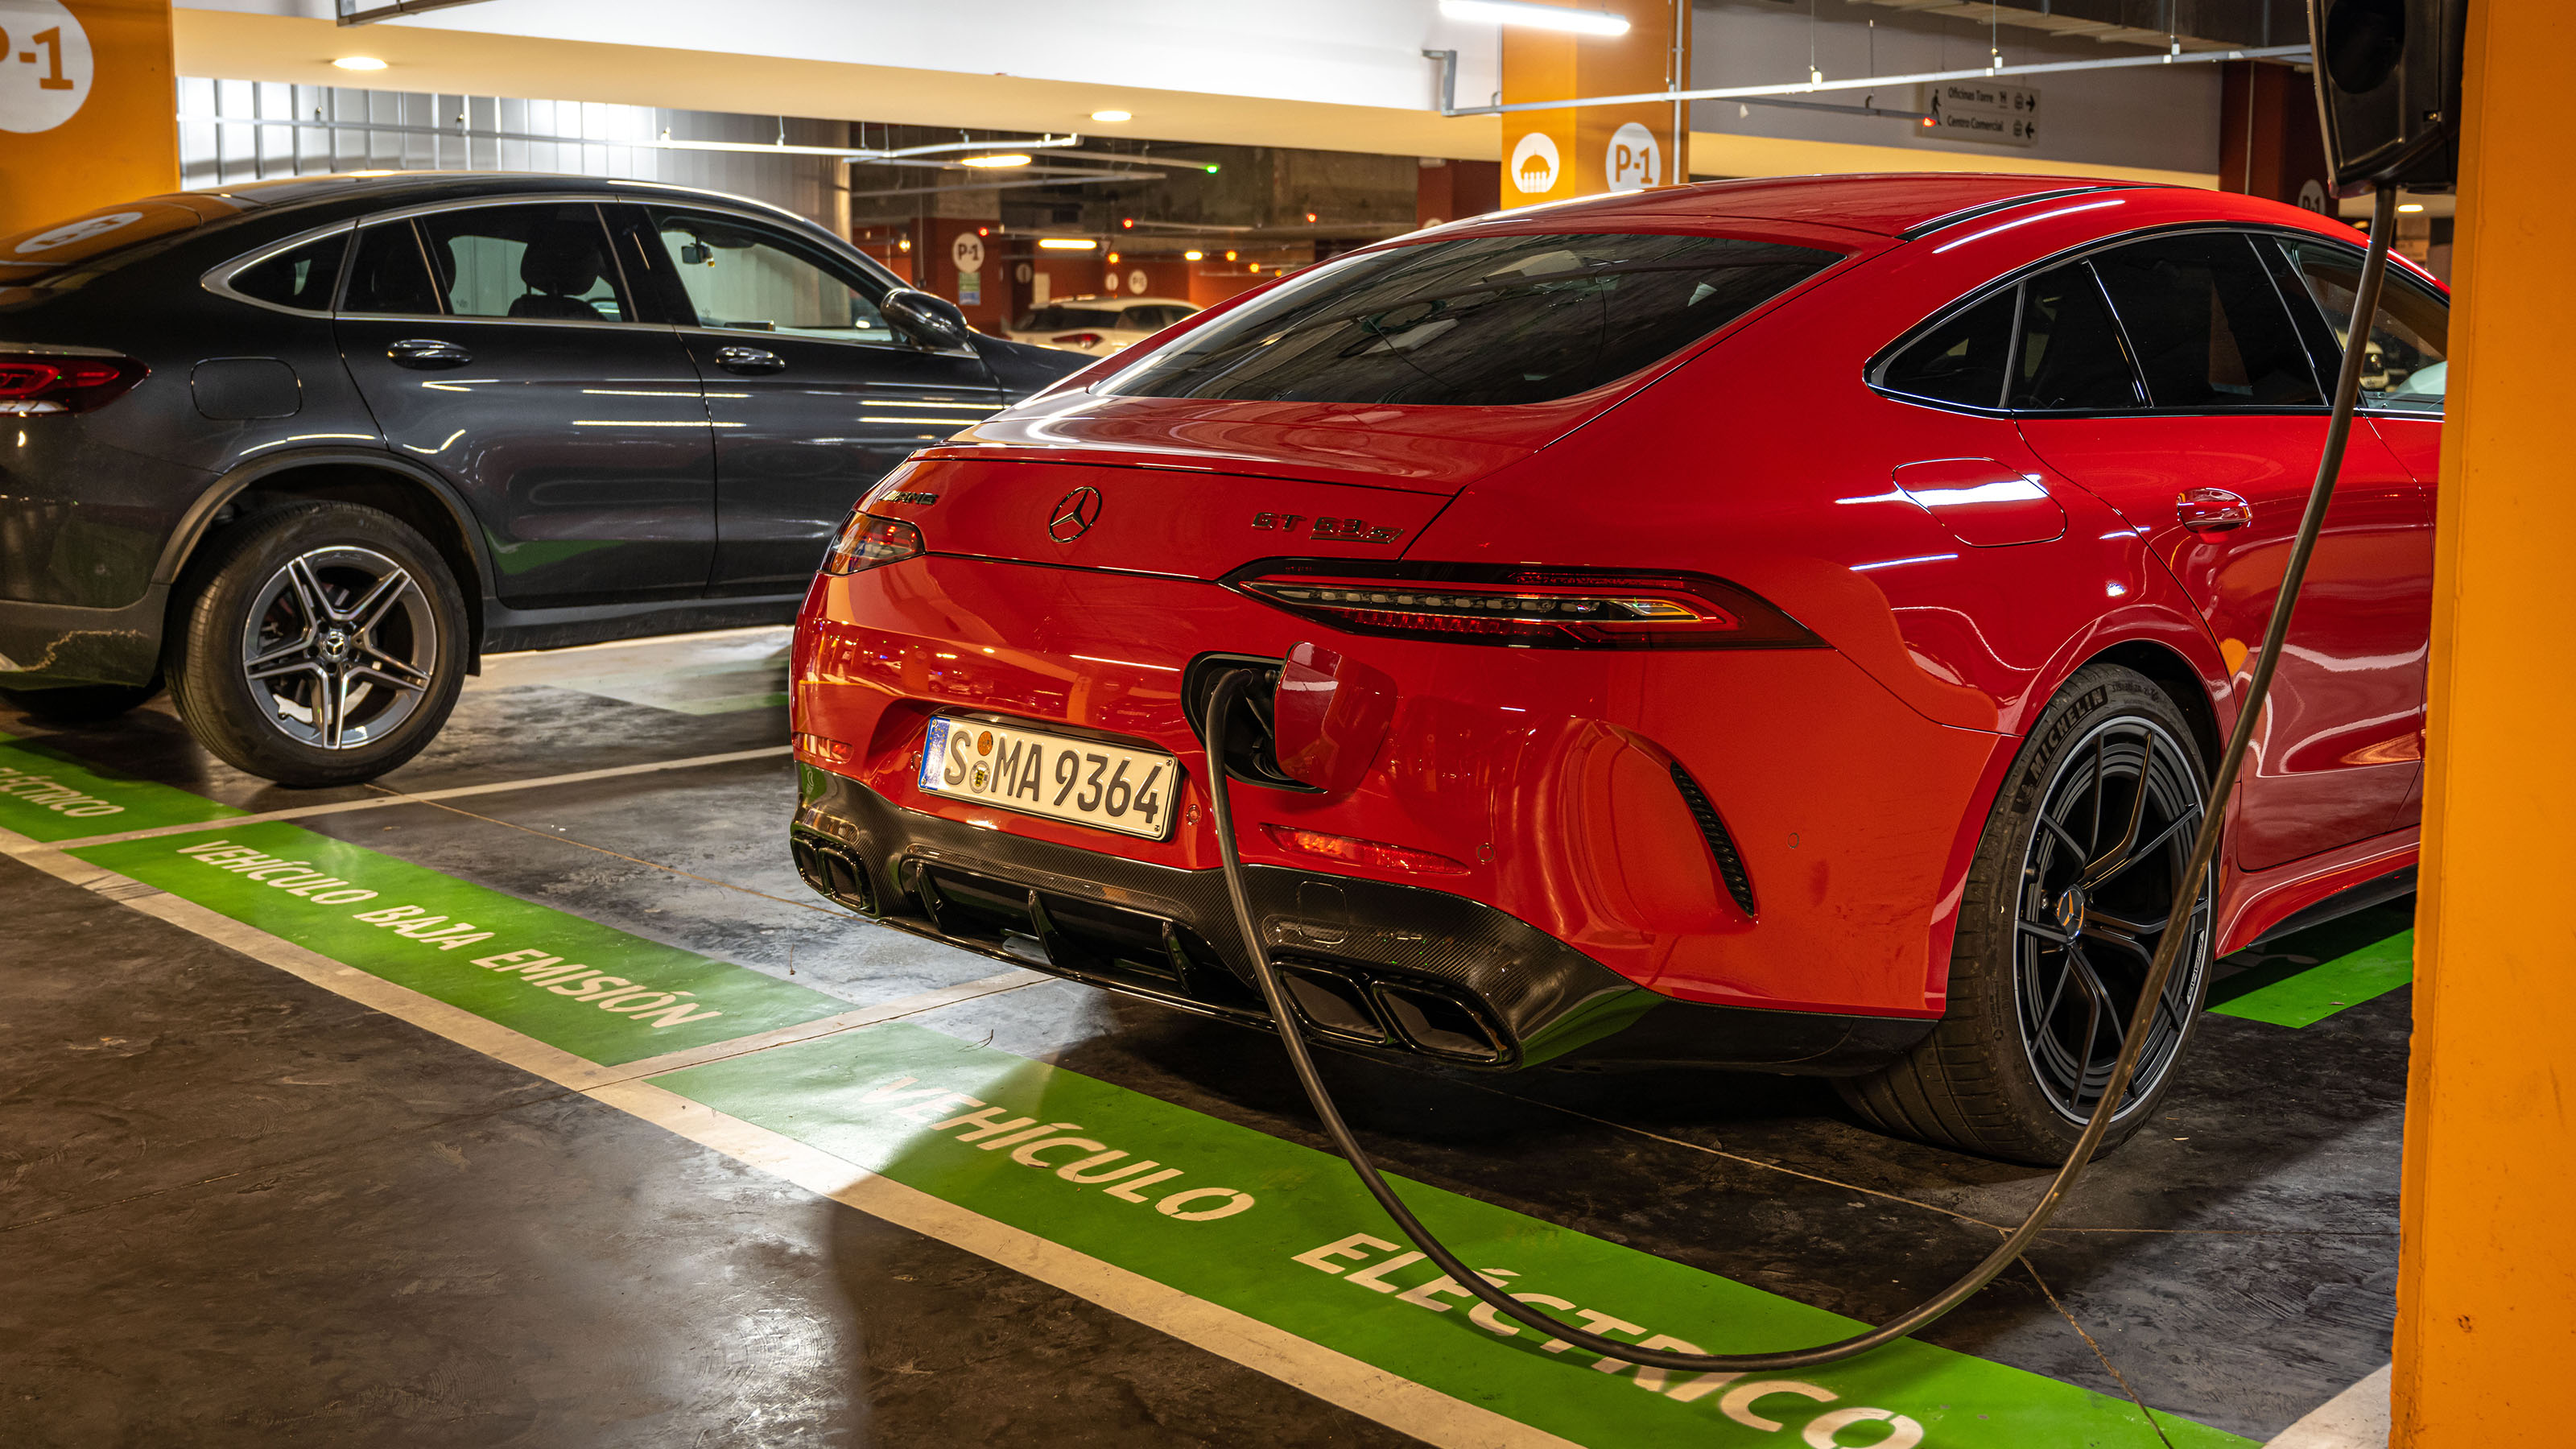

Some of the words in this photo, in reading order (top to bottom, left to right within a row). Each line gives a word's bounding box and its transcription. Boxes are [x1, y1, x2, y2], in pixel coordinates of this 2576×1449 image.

[1947, 86, 1975, 101] Oficinas
[1975, 89, 1994, 103] Torre
[1946, 114, 1970, 129] Centro
[1971, 118, 2004, 132] Comercial
[1616, 144, 1653, 184] P-1
[957, 242, 980, 261] P-1
[1252, 512, 1308, 530] GT
[2029, 687, 2105, 781] MICHELIN
[0, 766, 126, 817] ÉCTRICO
[943, 730, 972, 786] S
[990, 737, 1042, 802] MA
[1053, 749, 1162, 824] 9364
[176, 840, 379, 905] VEHÍCULO
[353, 905, 495, 951] BAJA
[469, 948, 723, 1028] EMISIÓN
[859, 1076, 1255, 1221] VEHÍCULO
